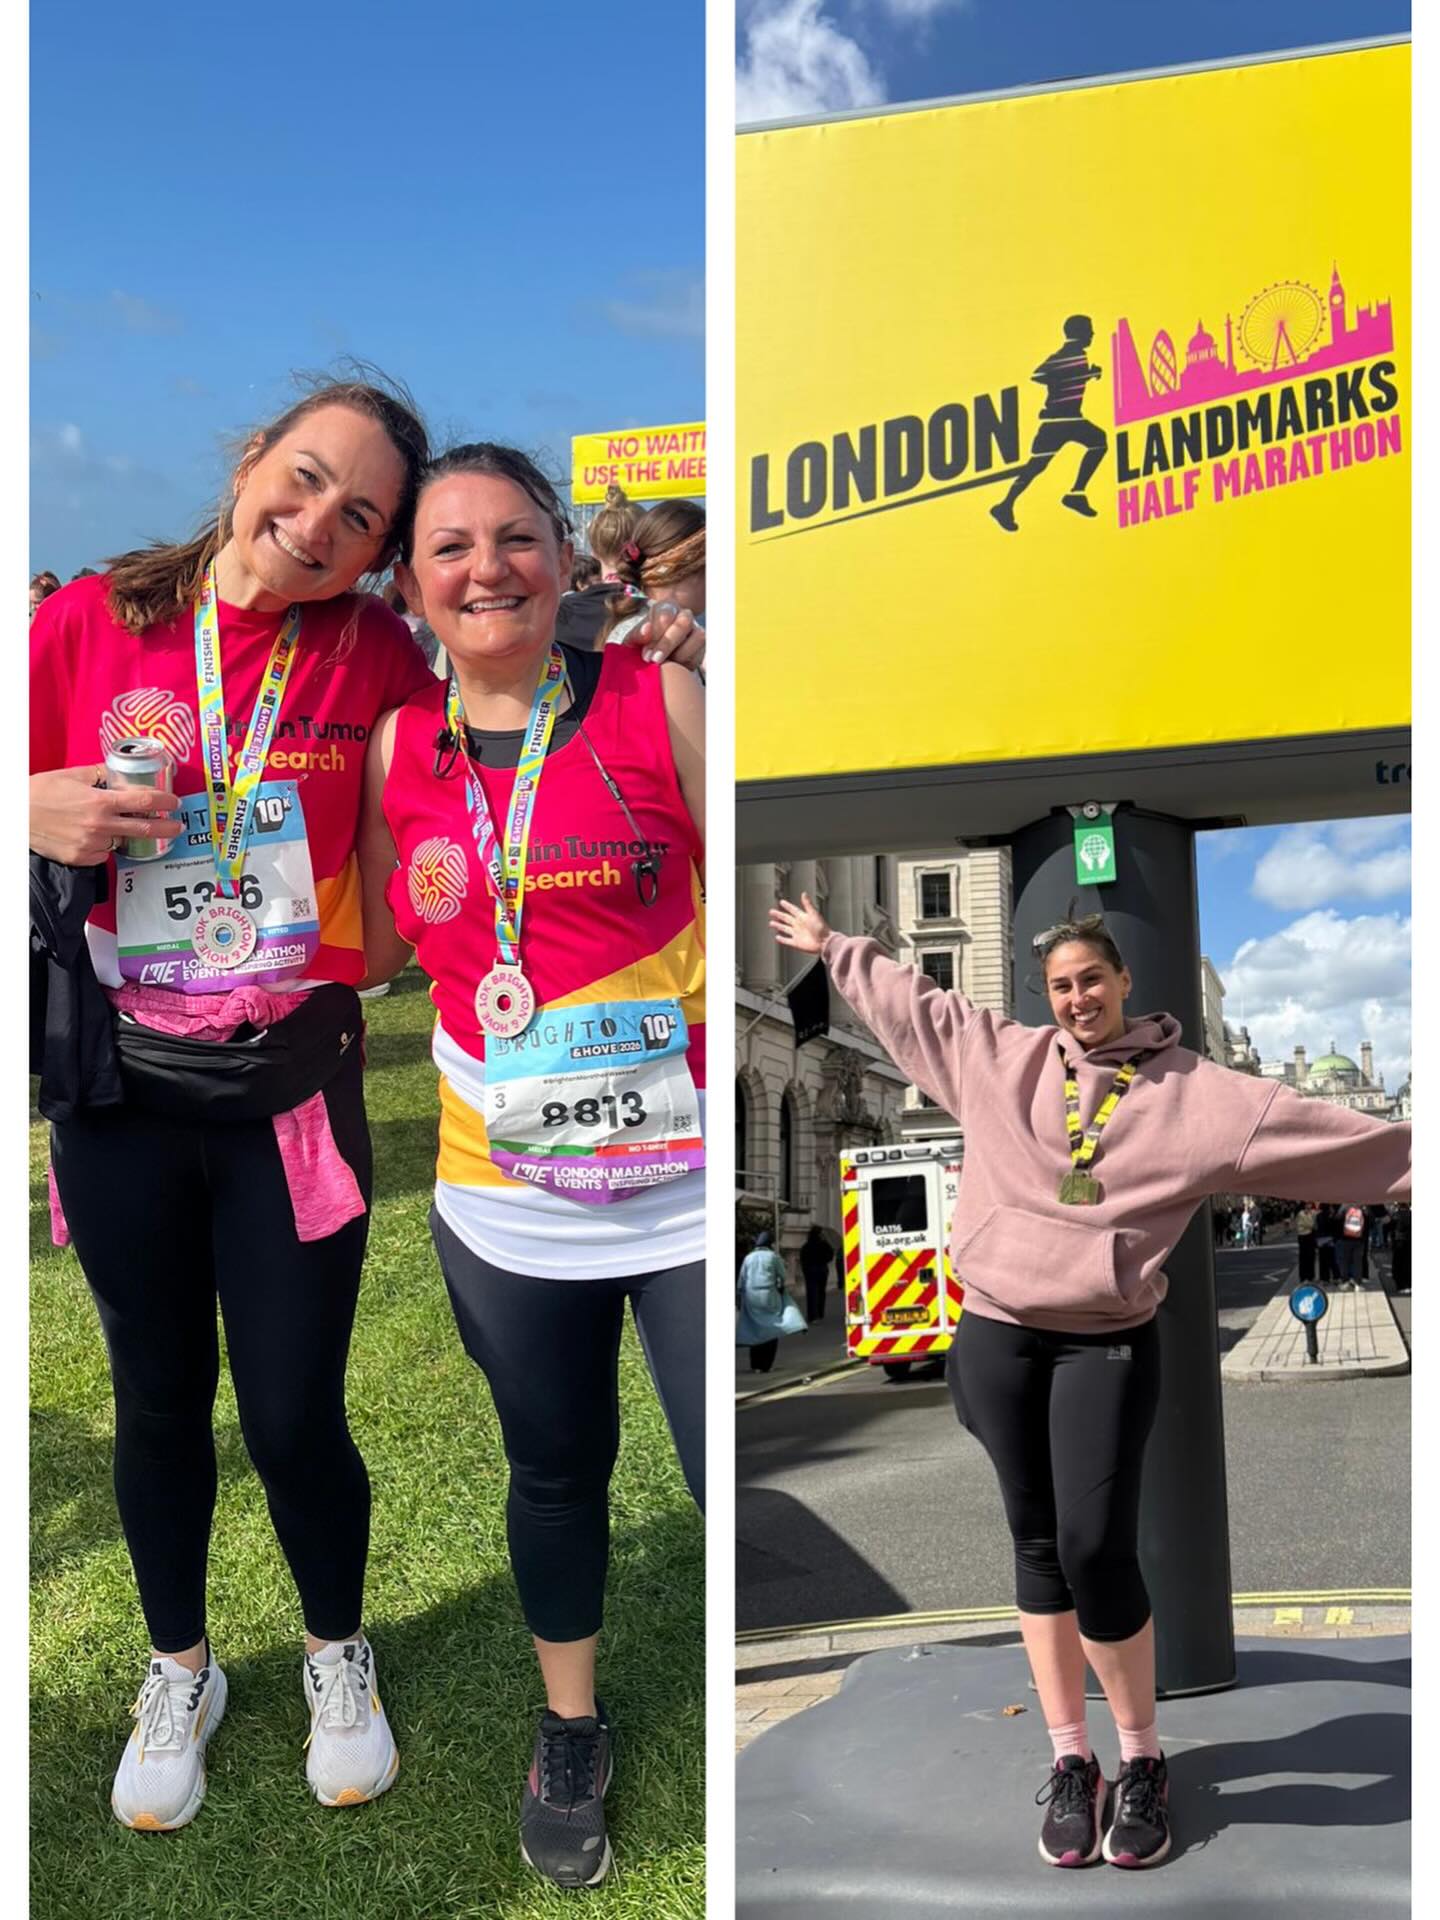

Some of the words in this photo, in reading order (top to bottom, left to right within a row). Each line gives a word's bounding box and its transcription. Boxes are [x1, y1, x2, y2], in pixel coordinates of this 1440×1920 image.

[1116, 360, 1399, 483] LANDMARKS
[608, 437, 639, 459] NO
[750, 385, 1020, 533] LONDON
[584, 464, 619, 485] USE
[625, 461, 661, 482] THE
[1118, 468, 1201, 528] HALF
[1213, 414, 1402, 503] MARATHON
[203, 629, 215, 684] FINISHER
[298, 716, 368, 741] Tumo
[530, 701, 551, 753] FINISHER
[227, 799, 247, 860] FINISHER
[125, 878, 133, 893] 3
[524, 861, 621, 892] search
[164, 874, 264, 920] 536
[195, 916, 209, 940] 10K
[209, 906, 251, 951] BRIGHTON
[199, 944, 229, 964] HOVE
[250, 944, 305, 961] ARATHON
[479, 984, 492, 1007] 10K
[491, 972, 530, 1020] BRIGHTON
[481, 1011, 508, 1033] HOVE
[495, 1015, 638, 1056] BRIGHTON
[643, 1014, 676, 1042] 10K
[620, 1041, 641, 1052] 2026
[495, 1092, 506, 1109] 3
[542, 1091, 648, 1128] 8813
[554, 1166, 609, 1180] LONDON
[611, 1161, 689, 1179] MARATHON
[554, 1177, 603, 1190] EVENTS
[876, 1234, 927, 1248] sja.org.uk
